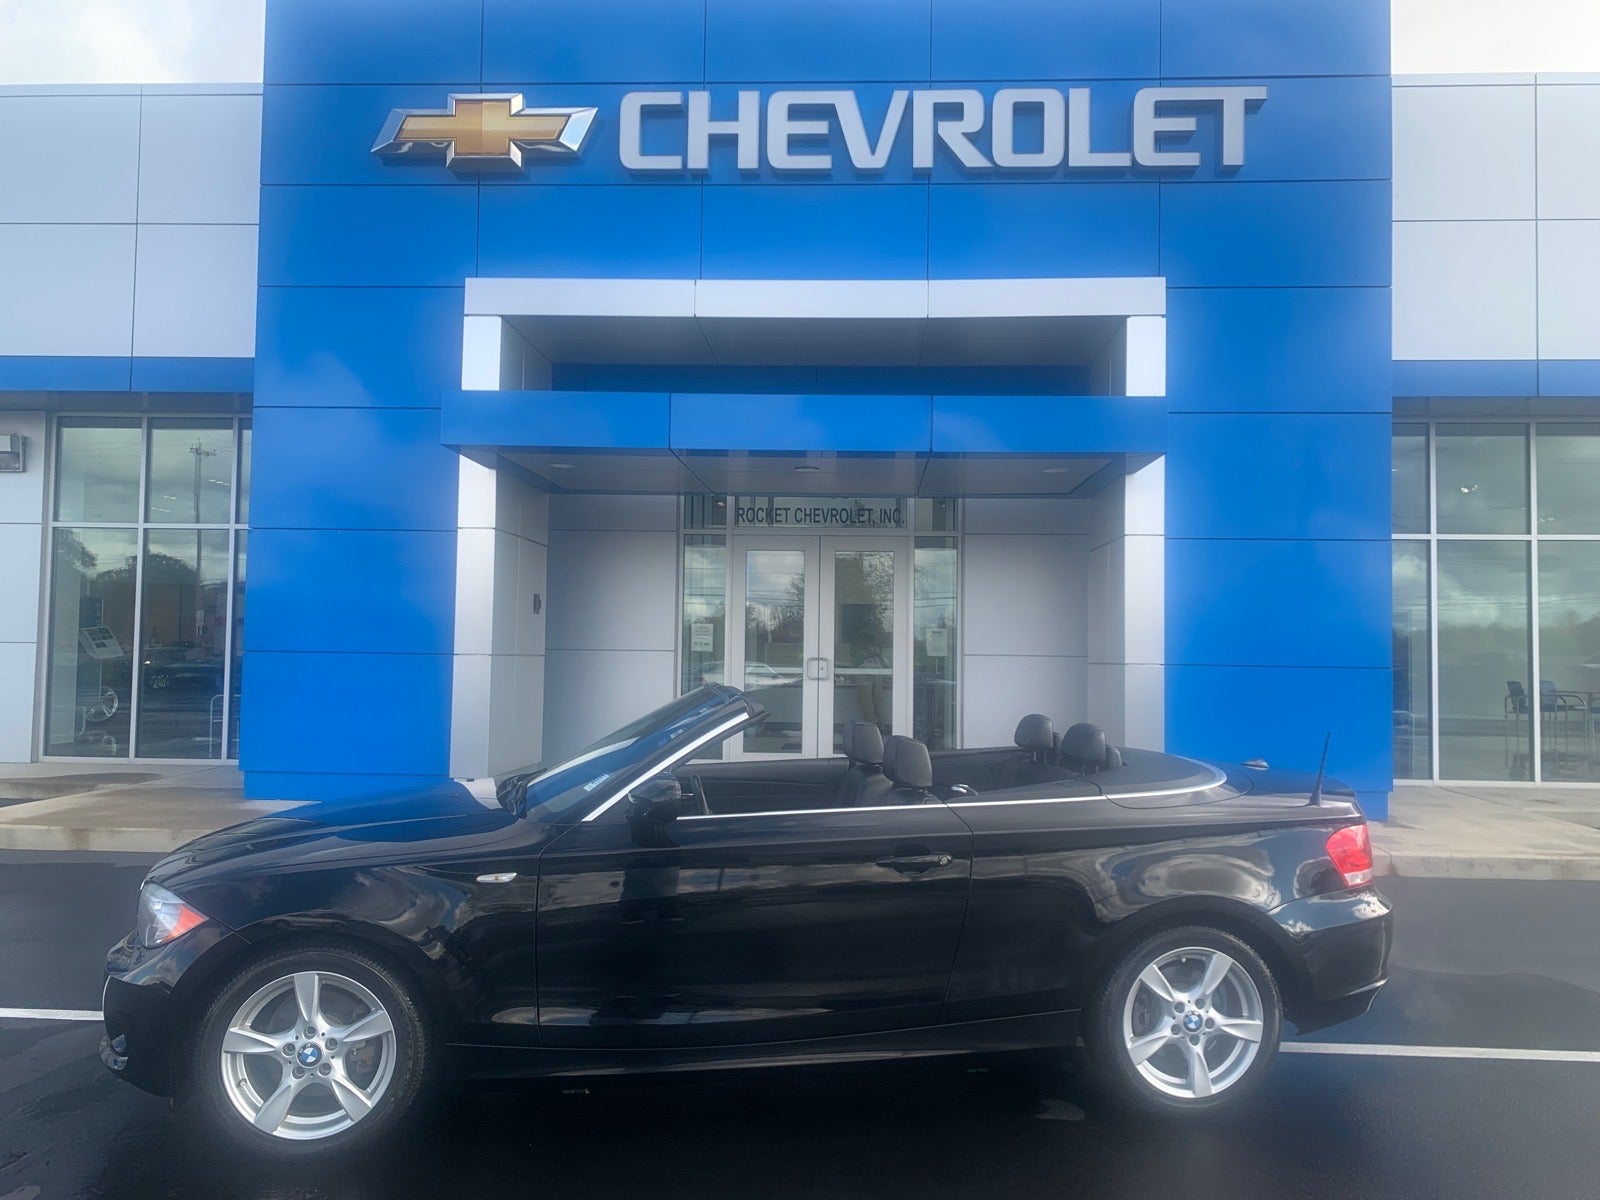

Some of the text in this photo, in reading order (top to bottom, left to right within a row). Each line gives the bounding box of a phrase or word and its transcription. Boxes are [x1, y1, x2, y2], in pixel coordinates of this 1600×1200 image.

[619, 85, 1268, 170] CHEVROLET
[737, 507, 905, 526] ROCKET CHEVROLET, INC.
